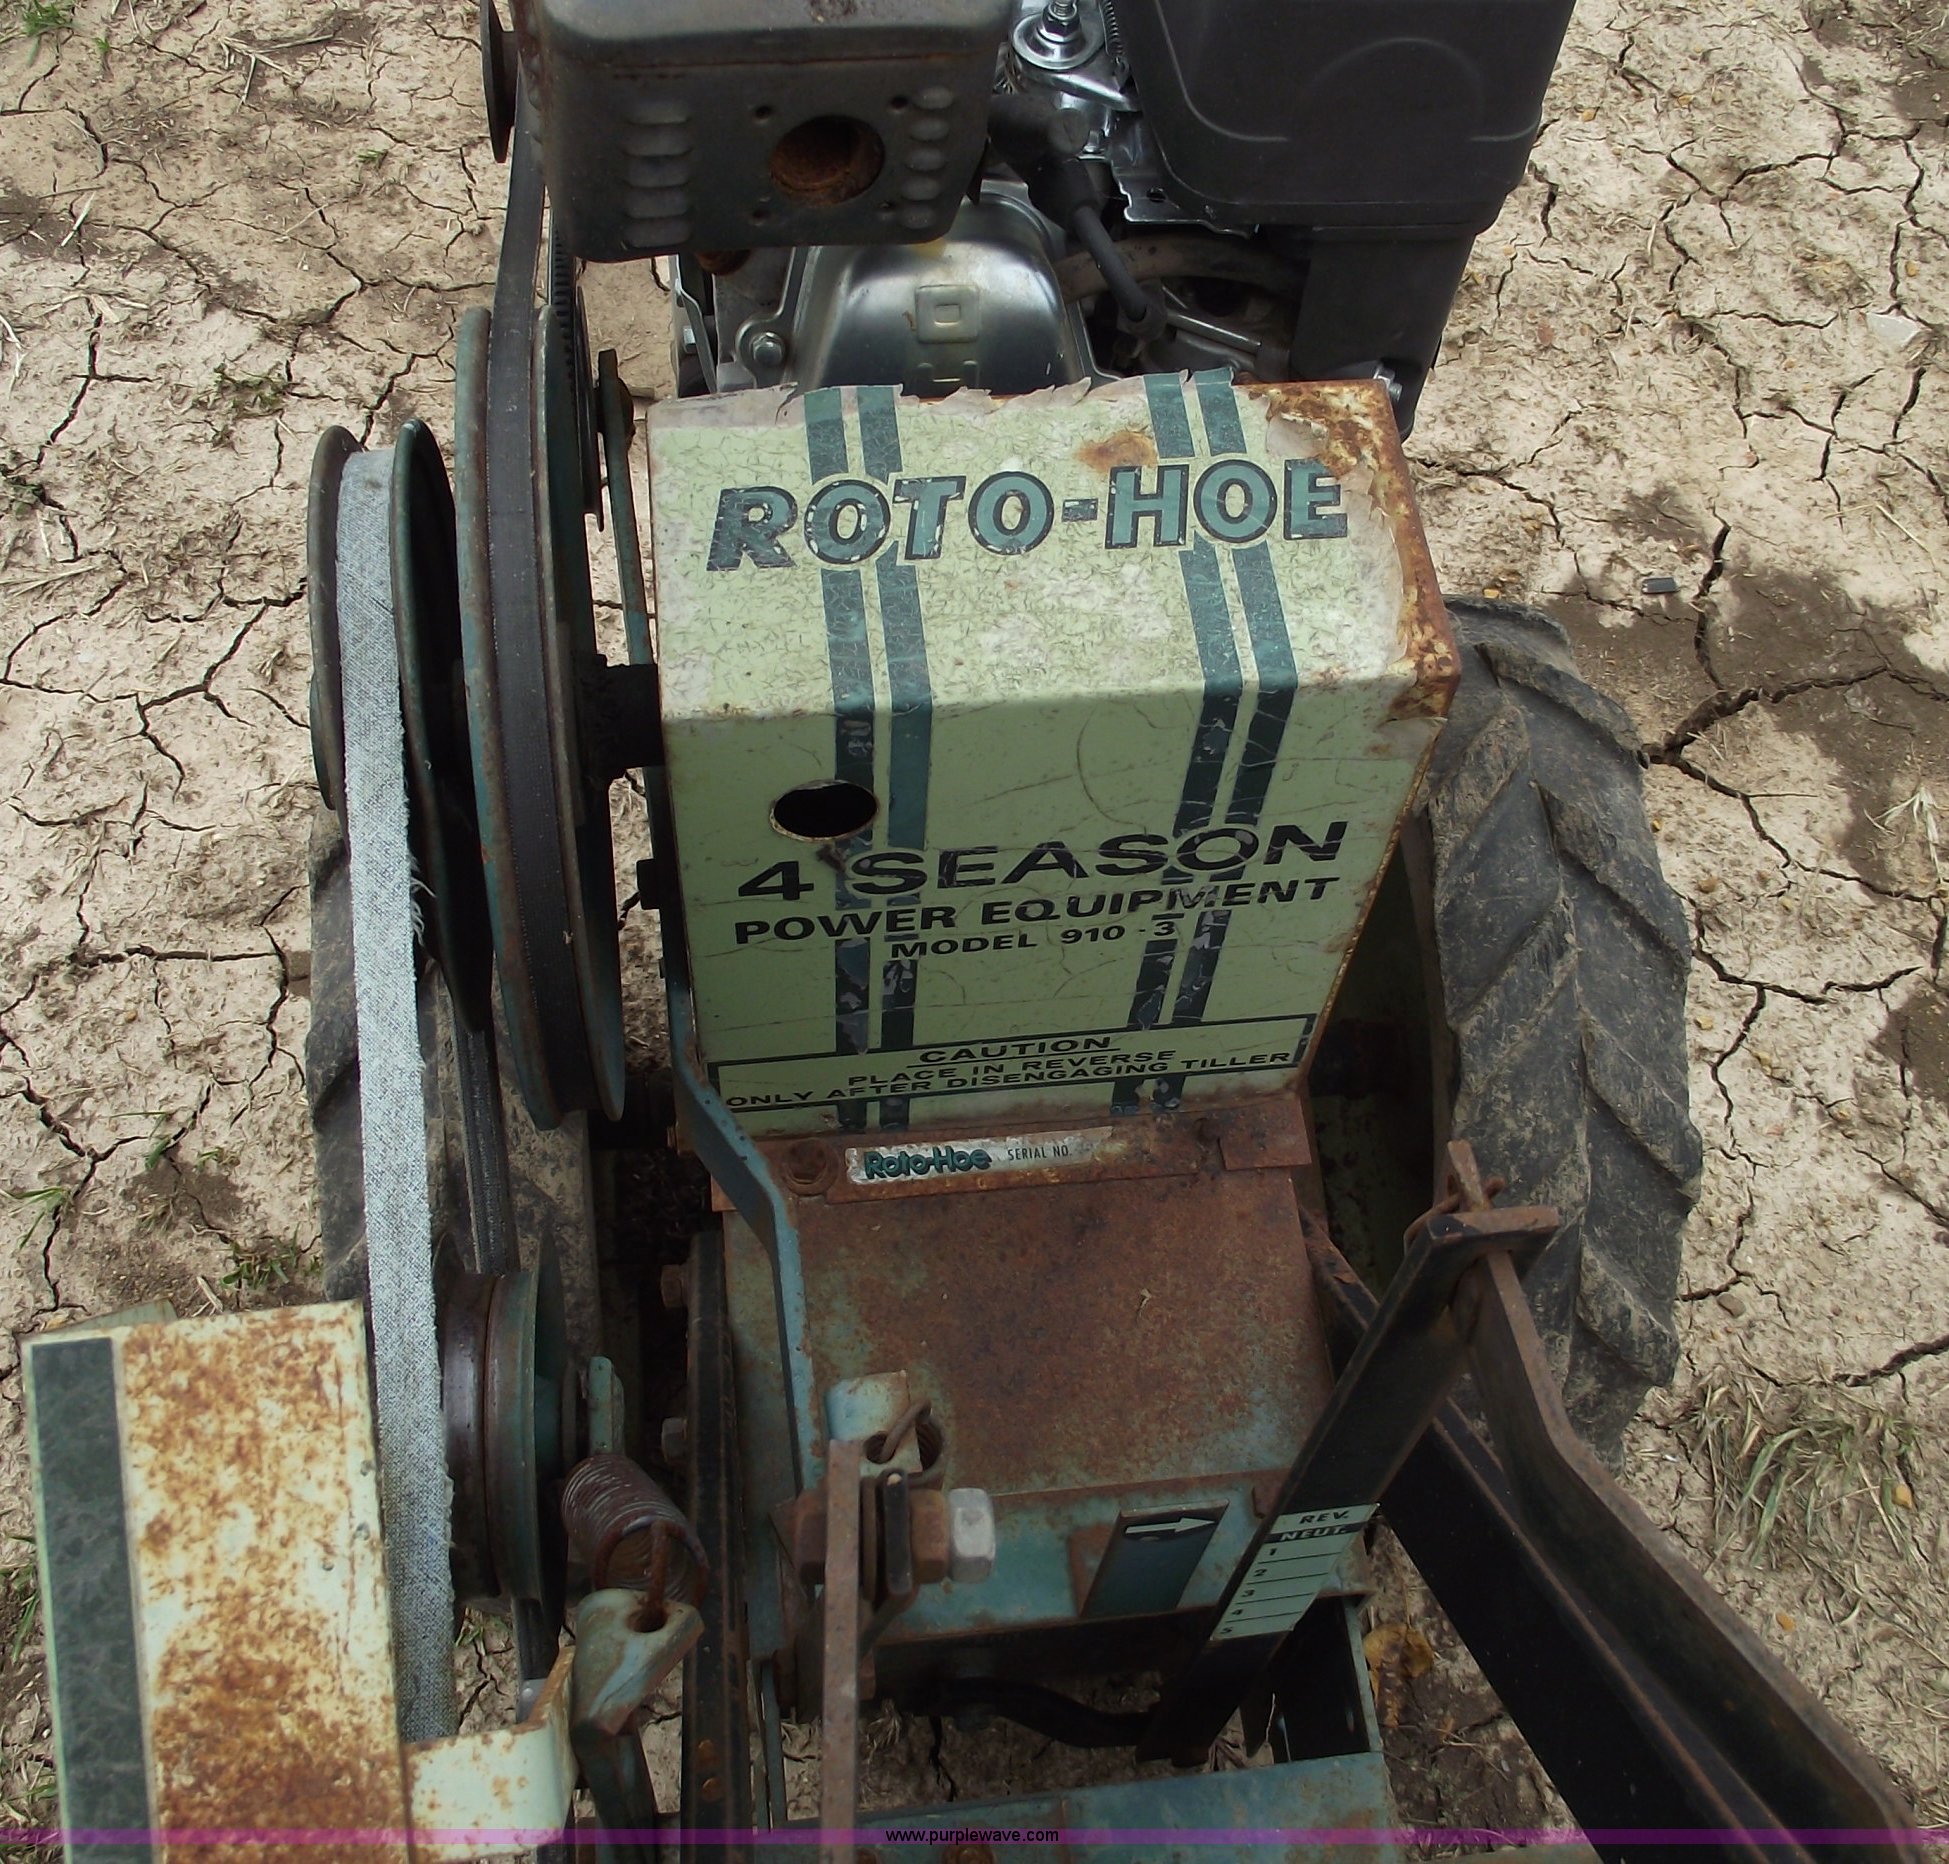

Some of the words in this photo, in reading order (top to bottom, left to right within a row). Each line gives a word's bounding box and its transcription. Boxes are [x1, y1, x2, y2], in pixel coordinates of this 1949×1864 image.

[706, 458, 1349, 572] ROTO-HOE
[738, 861, 814, 901] 4
[851, 820, 1349, 895] SEASON
[735, 906, 957, 944] POWER
[981, 877, 1340, 925] EQUIPMENT
[891, 933, 1038, 958] MODEL
[920, 1036, 1111, 1063] CAUTION
[848, 1067, 957, 1086] PLACE
[973, 1063, 1004, 1075] IN
[1022, 1050, 1176, 1070] REVERSE
[726, 1091, 813, 1107] ONLY
[826, 1081, 931, 1098] AFTER
[947, 1062, 1168, 1088] DISENGAGING
[1181, 1052, 1291, 1069] TILLER
[1007, 1149, 1048, 1161] SERIAL
[1053, 1145, 1073, 1157] NO.
[1300, 1511, 1349, 1524] REV.
[1280, 1527, 1346, 1541] NEUT.
[1269, 1547, 1278, 1556] 1
[1253, 1569, 1267, 1577] 2
[1242, 1589, 1255, 1598] 3
[1231, 1608, 1243, 1616] 4
[1220, 1627, 1233, 1635] 5
